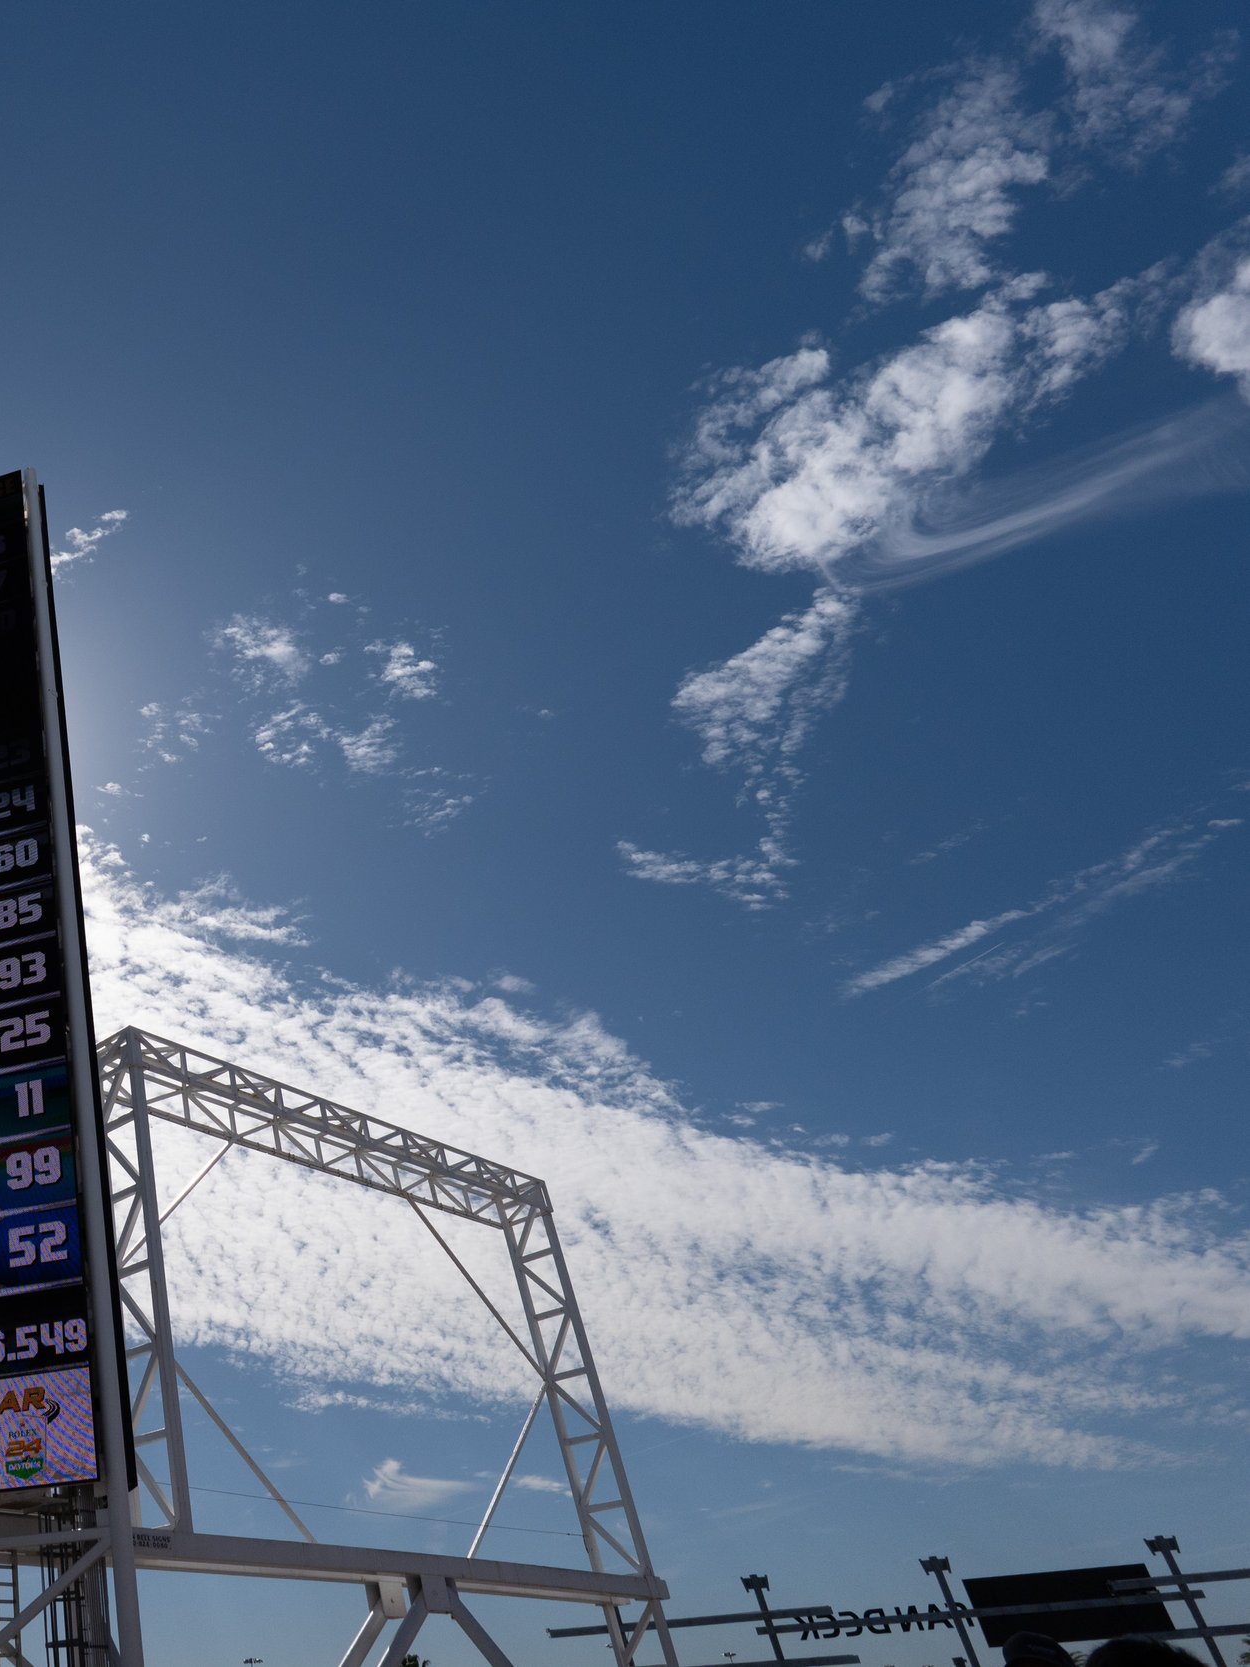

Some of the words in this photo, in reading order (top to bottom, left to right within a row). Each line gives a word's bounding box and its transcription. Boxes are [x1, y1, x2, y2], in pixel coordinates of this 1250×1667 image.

[0, 1010, 51, 1053] 25
[15, 1079, 44, 1118] 11
[6, 1146, 61, 1190] 99
[8, 1221, 68, 1268] 52
[5, 1438, 42, 1457] 24
[8, 1429, 37, 1439] ROLEX
